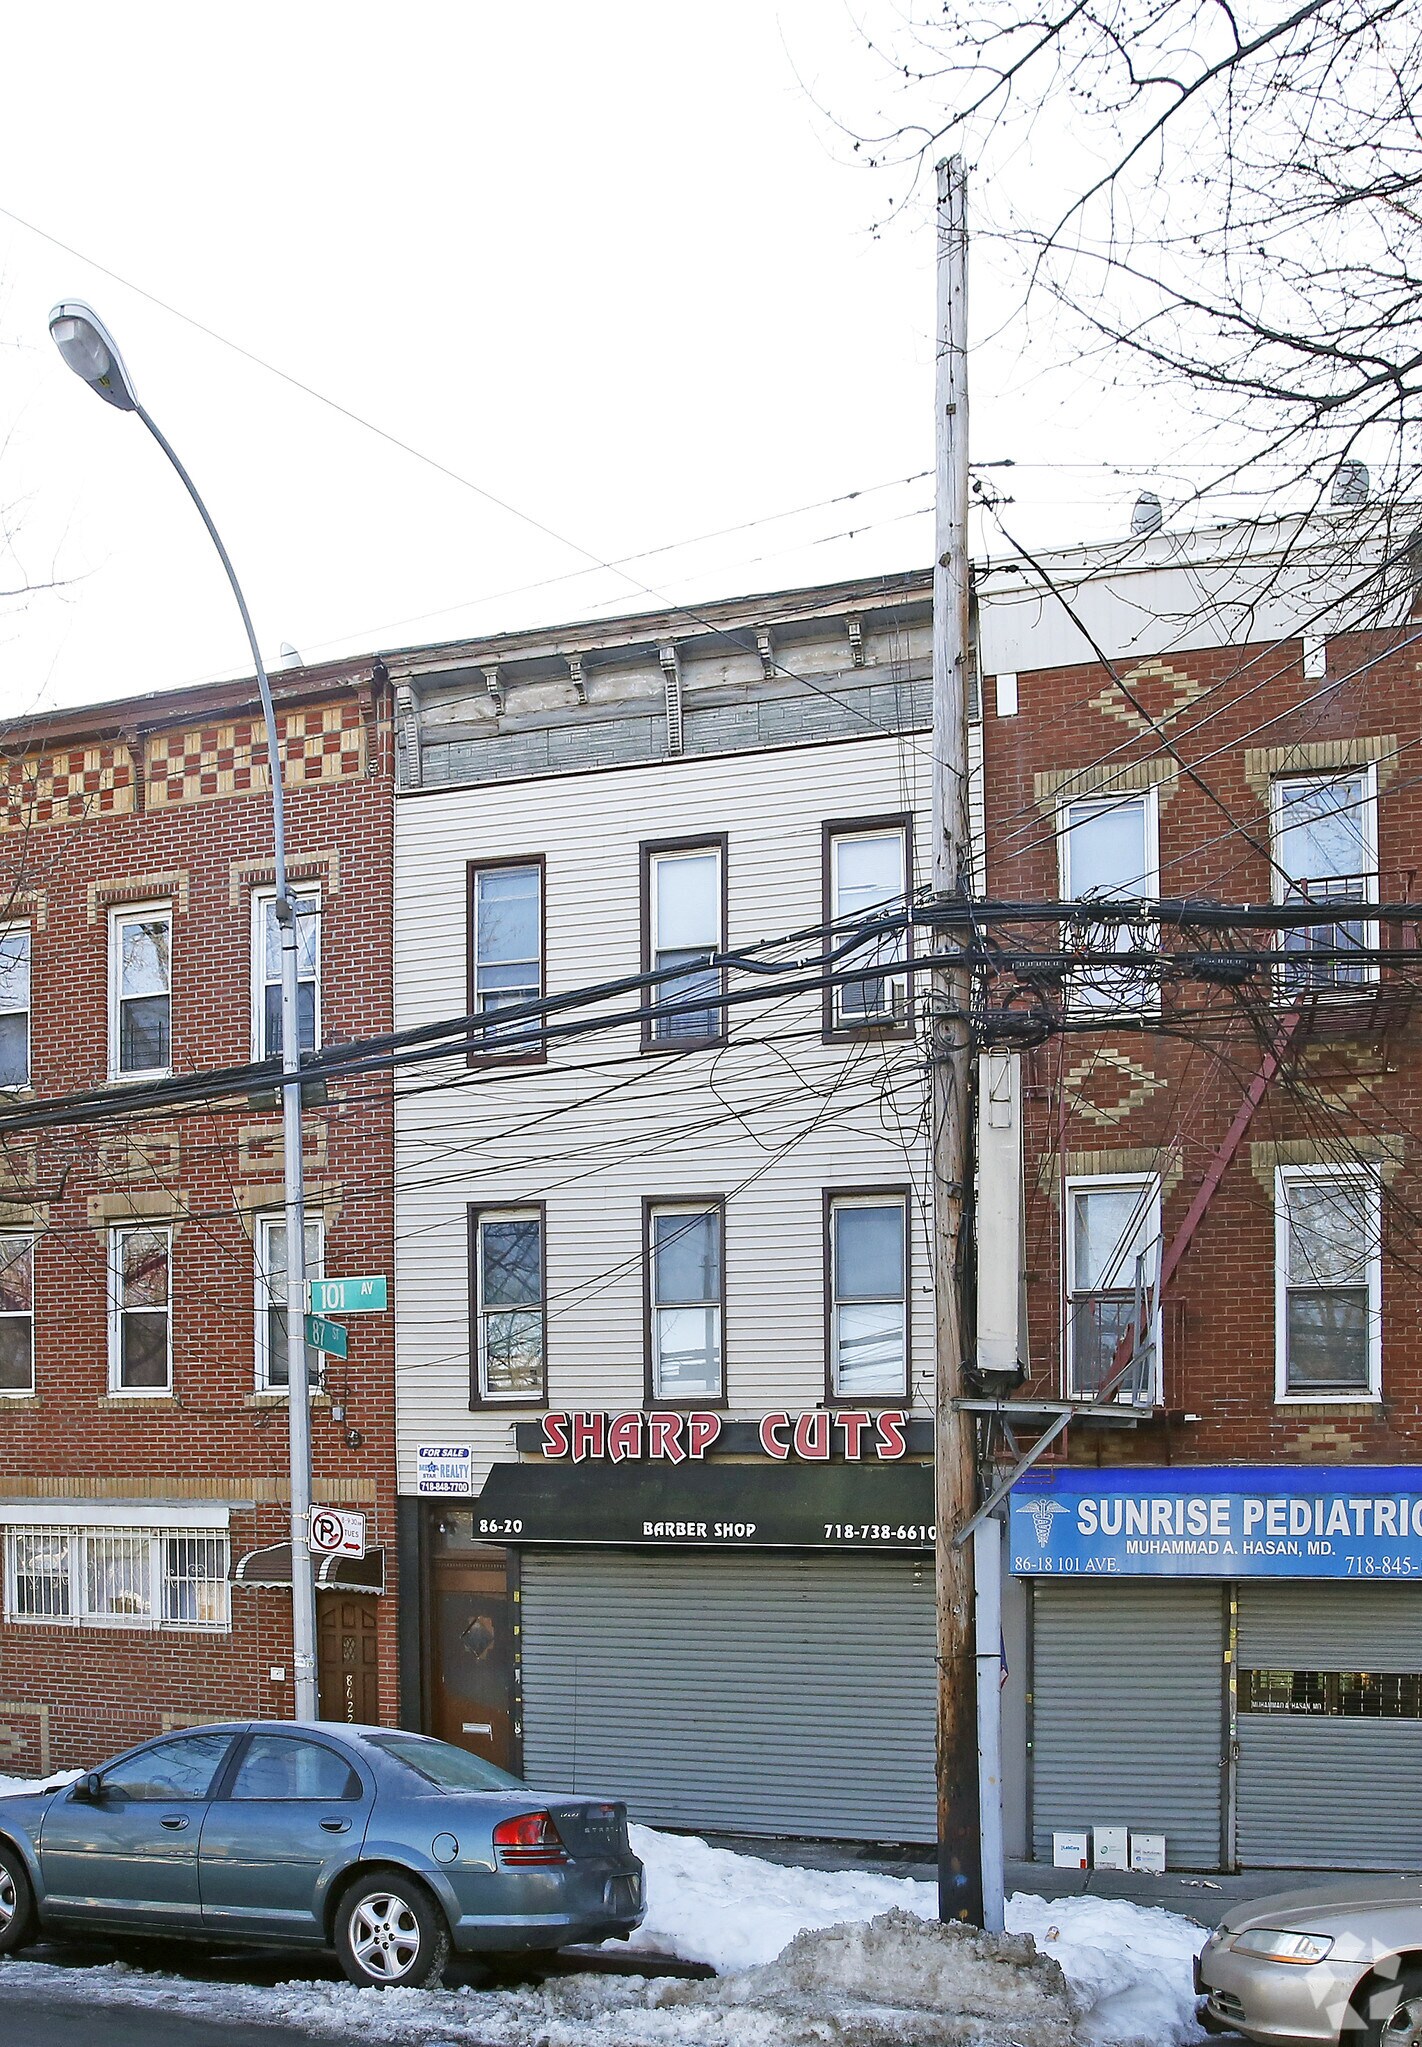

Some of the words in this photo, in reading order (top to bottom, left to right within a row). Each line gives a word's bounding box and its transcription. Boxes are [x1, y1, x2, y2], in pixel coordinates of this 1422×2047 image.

[321, 1283, 345, 1309] 101
[361, 1281, 374, 1295] AV
[312, 1320, 325, 1346] 87
[332, 1327, 339, 1340] ST
[541, 1410, 722, 1465] SHARP
[758, 1410, 909, 1460] CUTS
[422, 1448, 441, 1457] FOR
[441, 1449, 465, 1457] SALE
[440, 1464, 469, 1478] REALTY
[1077, 1498, 1231, 1536] SUNRISE
[345, 1529, 359, 1538] TUES
[479, 1519, 523, 1533] 86-20
[643, 1521, 708, 1538] BARBER
[714, 1522, 756, 1538] SHOP
[823, 1524, 937, 1540] 718-738-6610
[1126, 1540, 1219, 1555] MUHAMMAD
[1222, 1541, 1238, 1555] A.
[1243, 1541, 1302, 1558] HASAN,
[1307, 1541, 1336, 1556] MD.
[1015, 1557, 1052, 1571] 86-18
[1058, 1557, 1080, 1571] 101
[1085, 1558, 1120, 1572] AVE.
[1345, 1556, 1422, 1575] 718-845-
